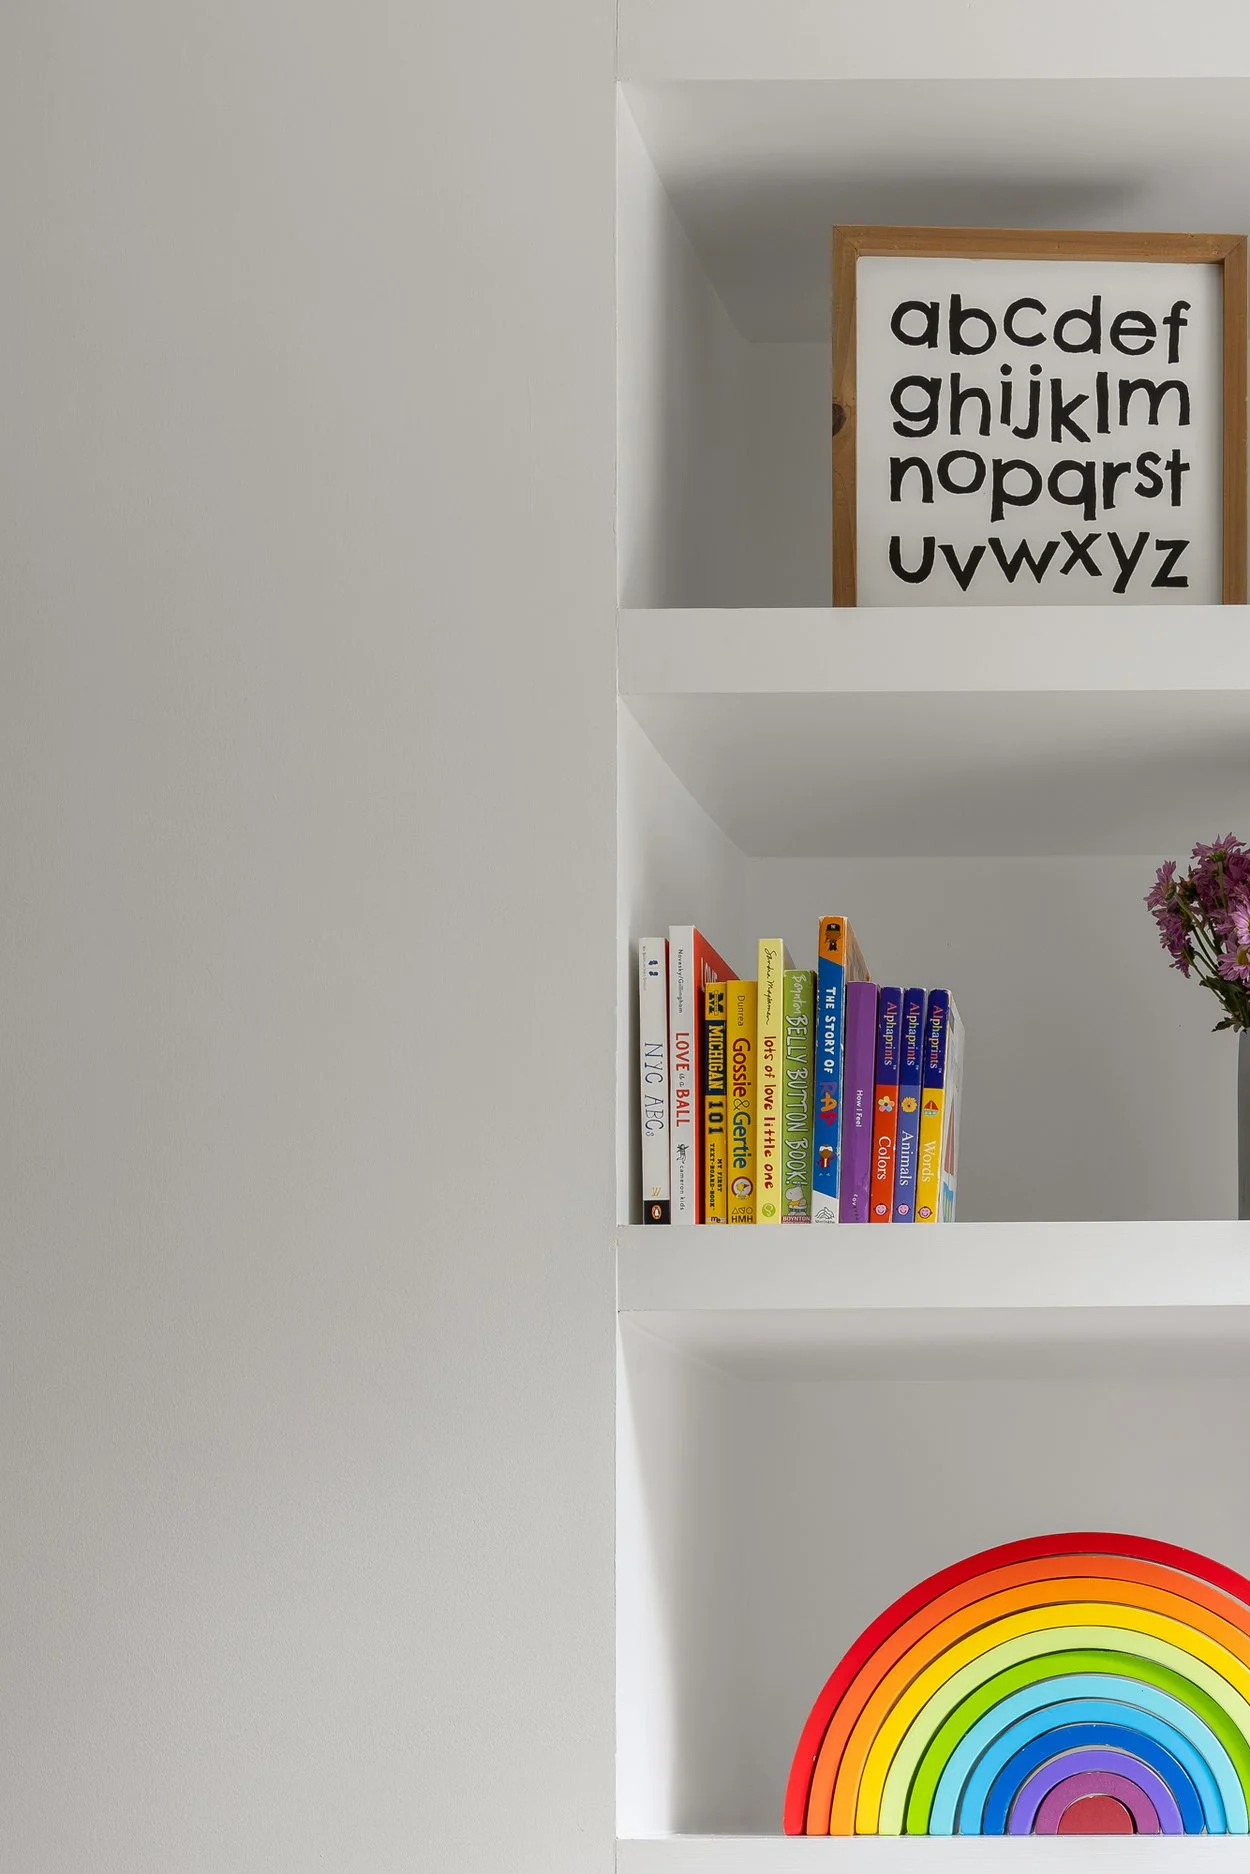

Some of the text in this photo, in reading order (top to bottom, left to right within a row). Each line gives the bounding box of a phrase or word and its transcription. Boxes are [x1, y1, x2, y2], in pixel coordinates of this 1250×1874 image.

[890, 363, 1191, 443] ghijklm
[890, 449, 1191, 522] nopqrst
[889, 531, 1190, 594] uvwxyz
[737, 995, 745, 1027] Dunrea
[883, 1002, 897, 1066] Alphaprints
[905, 1002, 920, 1066] Alphaprints
[928, 1005, 944, 1069] Alphaprints
[675, 1032, 690, 1071] LOVE
[708, 1025, 724, 1090] MICHIGAN
[732, 1037, 752, 1097] Gossie
[818, 986, 837, 1126] THE STORY OF RAP
[644, 1043, 664, 1137] NYC ABCs
[675, 1089, 690, 1128] BALL
[763, 1036, 777, 1189] lots of love little one
[785, 1014, 809, 1185] BELLY BUTTON BOOK!
[855, 1112, 863, 1128] Feel
[856, 1089, 864, 1107] How
[732, 1111, 752, 1169] Gertie
[877, 1136, 891, 1180] Colors
[900, 1130, 914, 1186] Animals
[921, 1140, 936, 1183] Words
[731, 1215, 753, 1223] HMH
